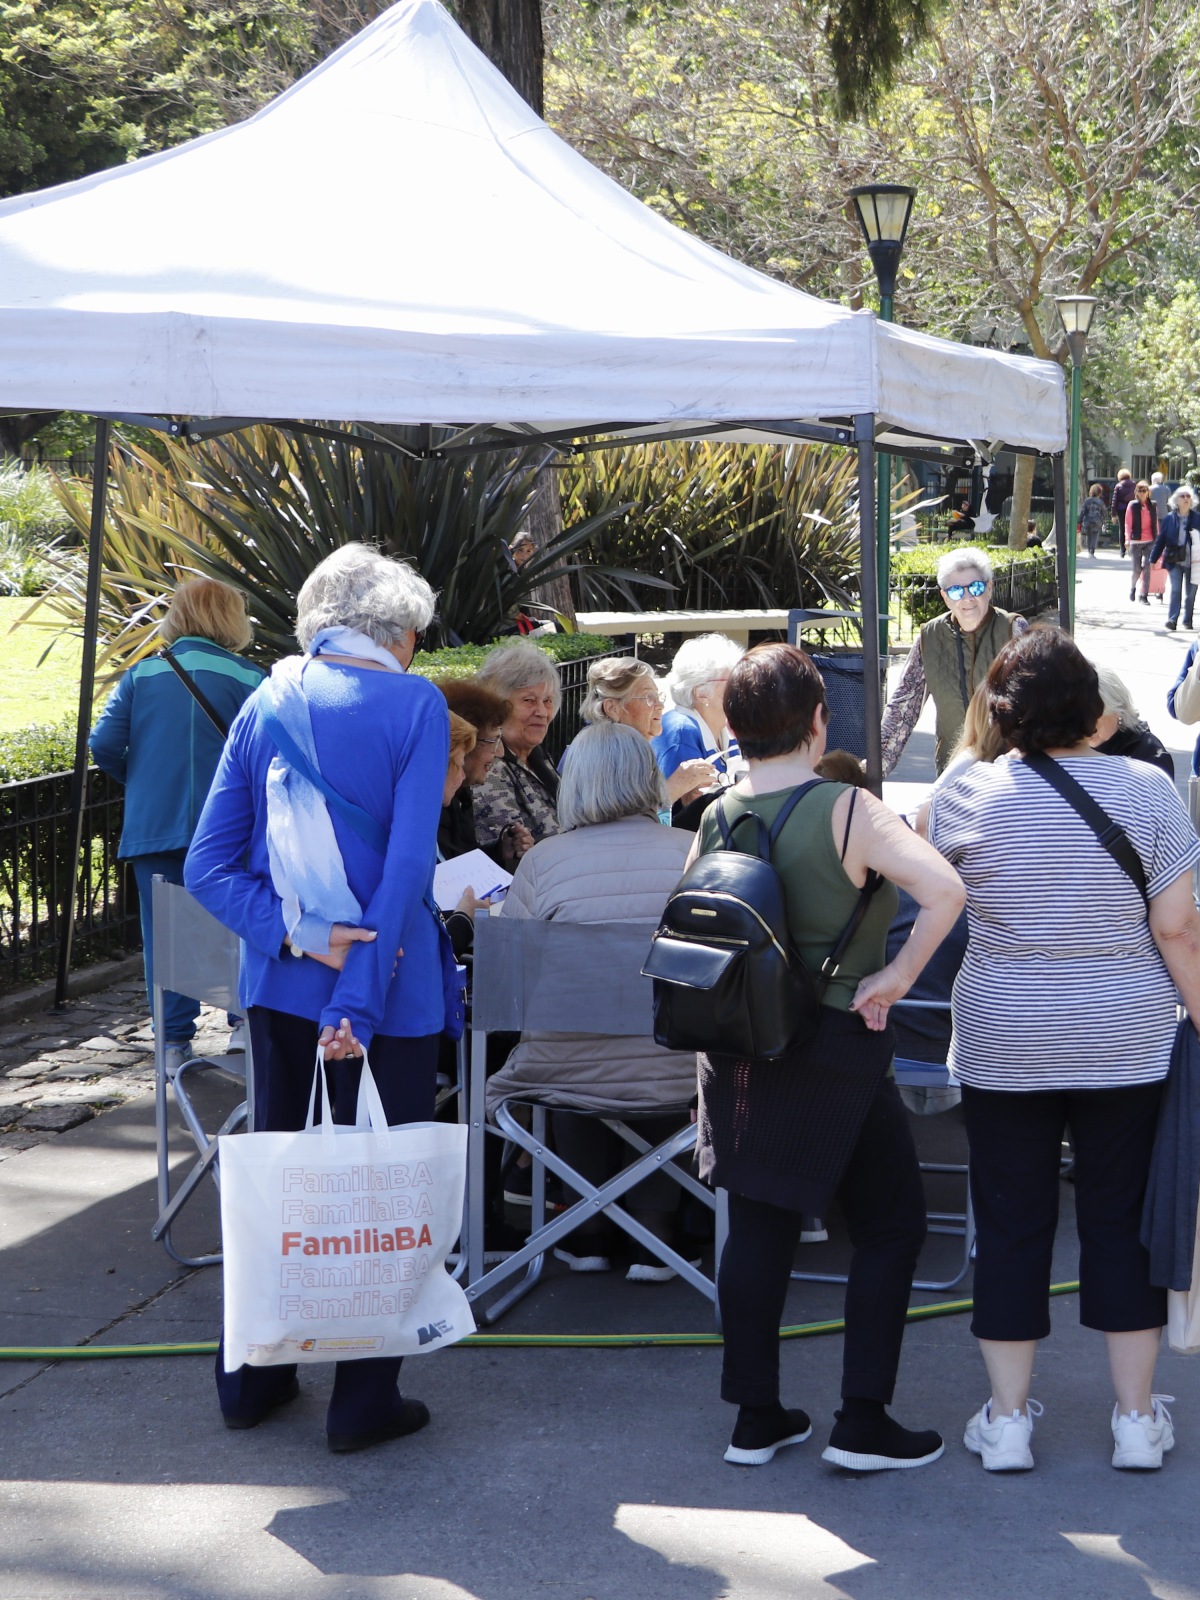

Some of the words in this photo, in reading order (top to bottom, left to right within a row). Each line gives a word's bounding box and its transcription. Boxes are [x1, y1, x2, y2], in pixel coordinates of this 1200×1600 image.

[283, 1162, 433, 1193] FamiliaBA
[282, 1192, 433, 1224] FamiliaBA
[281, 1223, 433, 1255] FamiliaBA
[280, 1254, 430, 1288] FamiliaBA
[279, 1287, 418, 1320] FamiliaB
